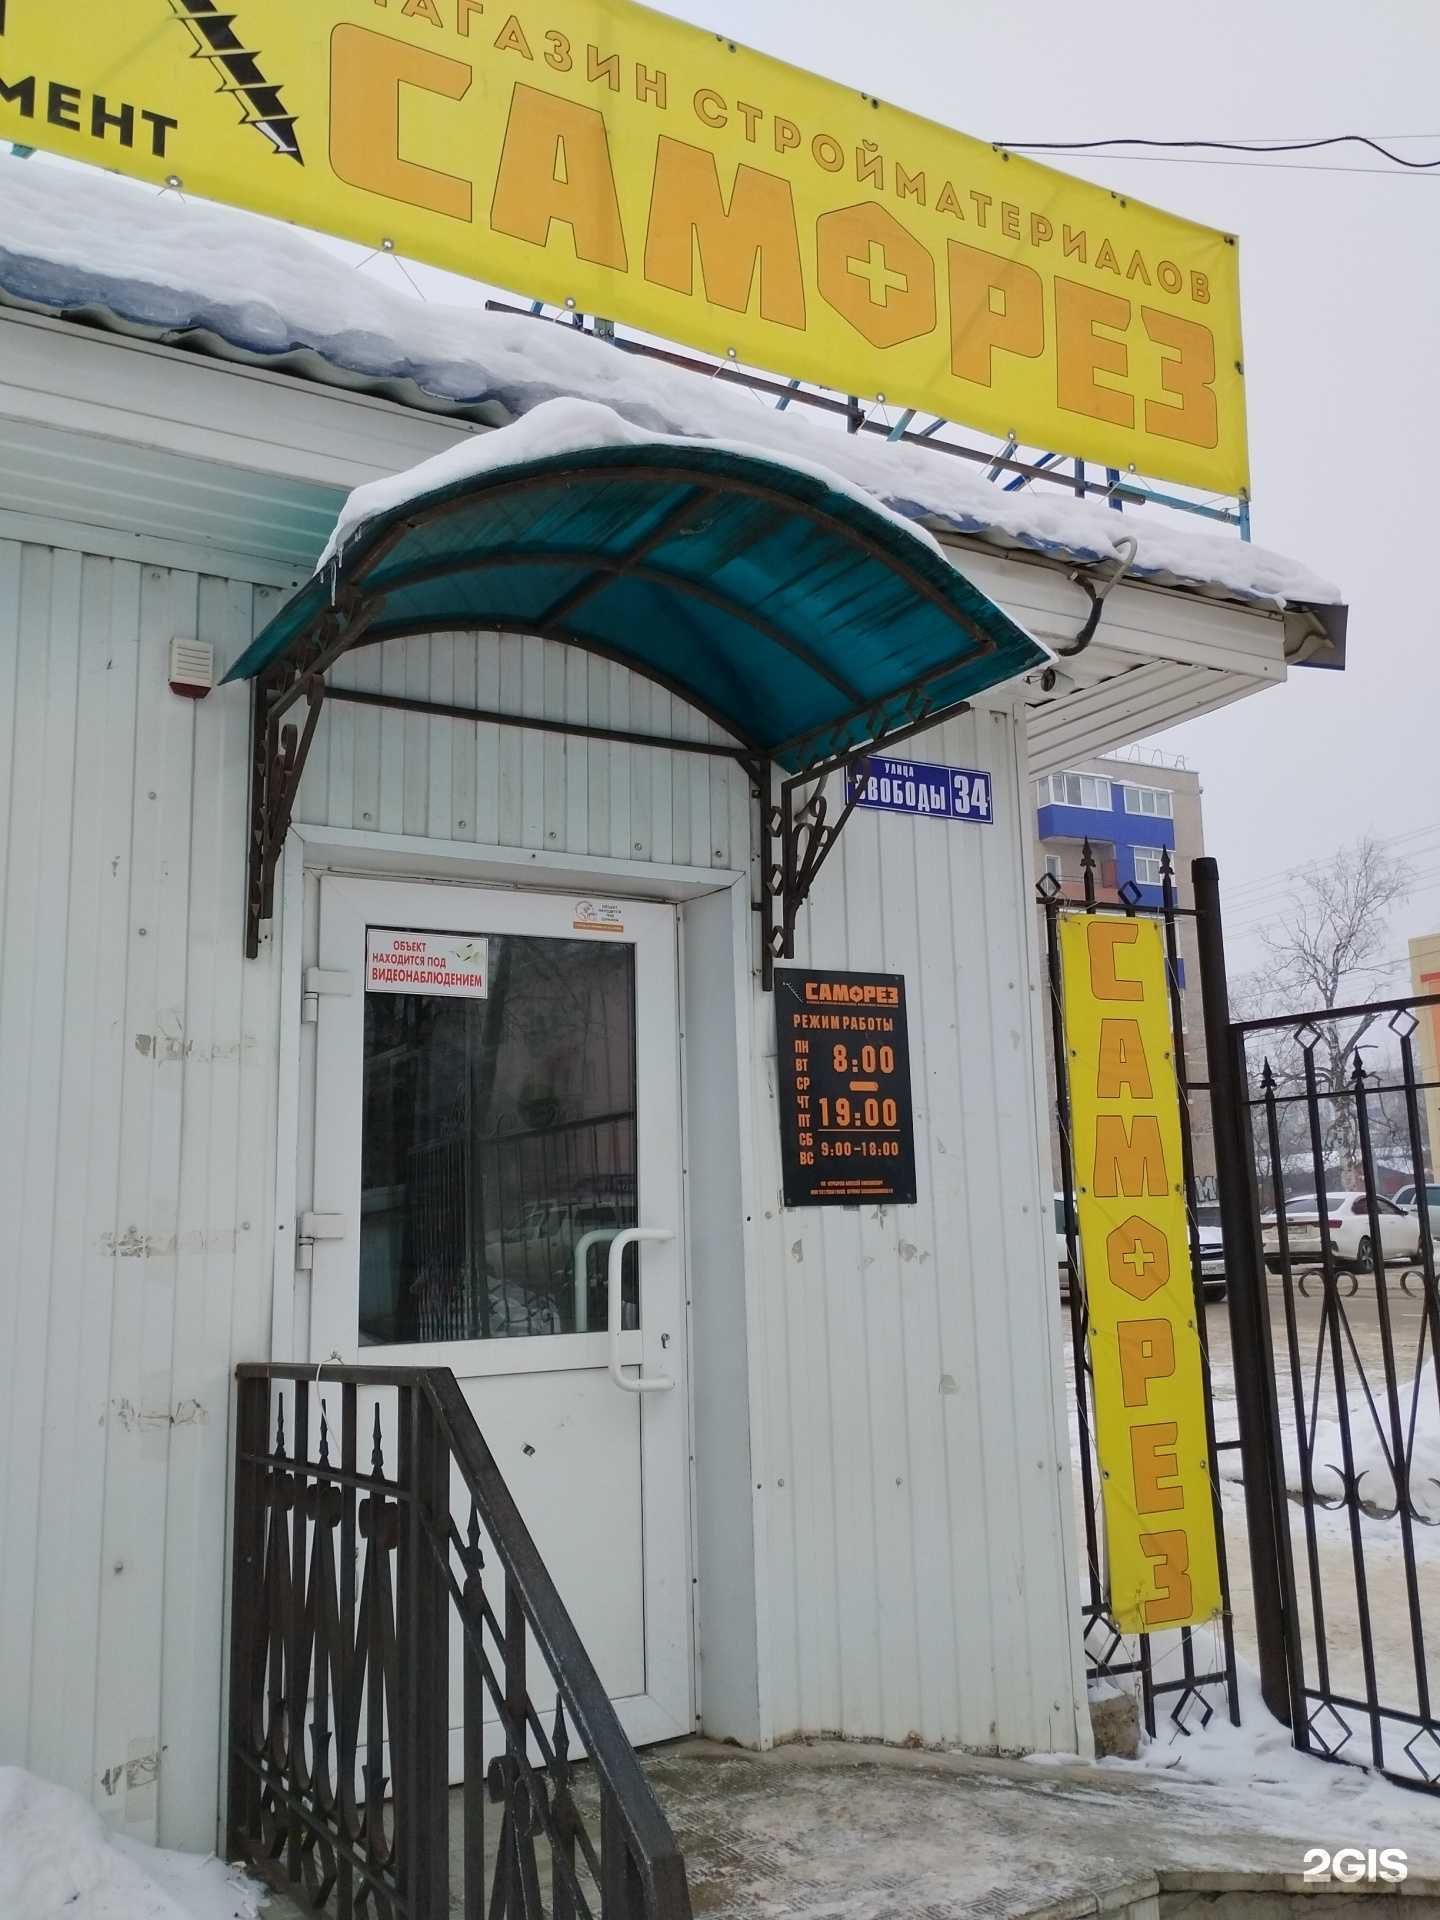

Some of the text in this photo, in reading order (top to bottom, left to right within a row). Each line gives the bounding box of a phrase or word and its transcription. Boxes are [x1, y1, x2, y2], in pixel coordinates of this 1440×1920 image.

[374, 0, 1211, 304] АГАЗИН СТРОЙМАТЕРИАЛОВ
[329, 22, 1218, 450] САМОРЕЗ
[885, 762, 914, 778] УЛИЦА
[954, 775, 988, 816] 34
[393, 940, 426, 952] ОБЪЕКТ
[372, 953, 446, 969] НАХОДИТСЯ ПОД
[372, 968, 482, 987] ВИДЕОНАБЛЮДЕНИЕМ
[805, 982, 899, 1003] САМОРЕЗ
[793, 1014, 893, 1032] РЕЖИМ РАБОТЫ
[794, 1040, 809, 1053] ПН
[795, 1058, 808, 1072] ВТ
[833, 1044, 894, 1073] 8:00
[796, 1077, 810, 1090] СР
[796, 1095, 810, 1109] ЧТ
[818, 1097, 896, 1127] 19:00
[798, 1114, 811, 1128] ПТ
[799, 1132, 813, 1146] СБ
[800, 1151, 814, 1165] ВС
[1086, 921, 1194, 1625] САМОРЕЗ
